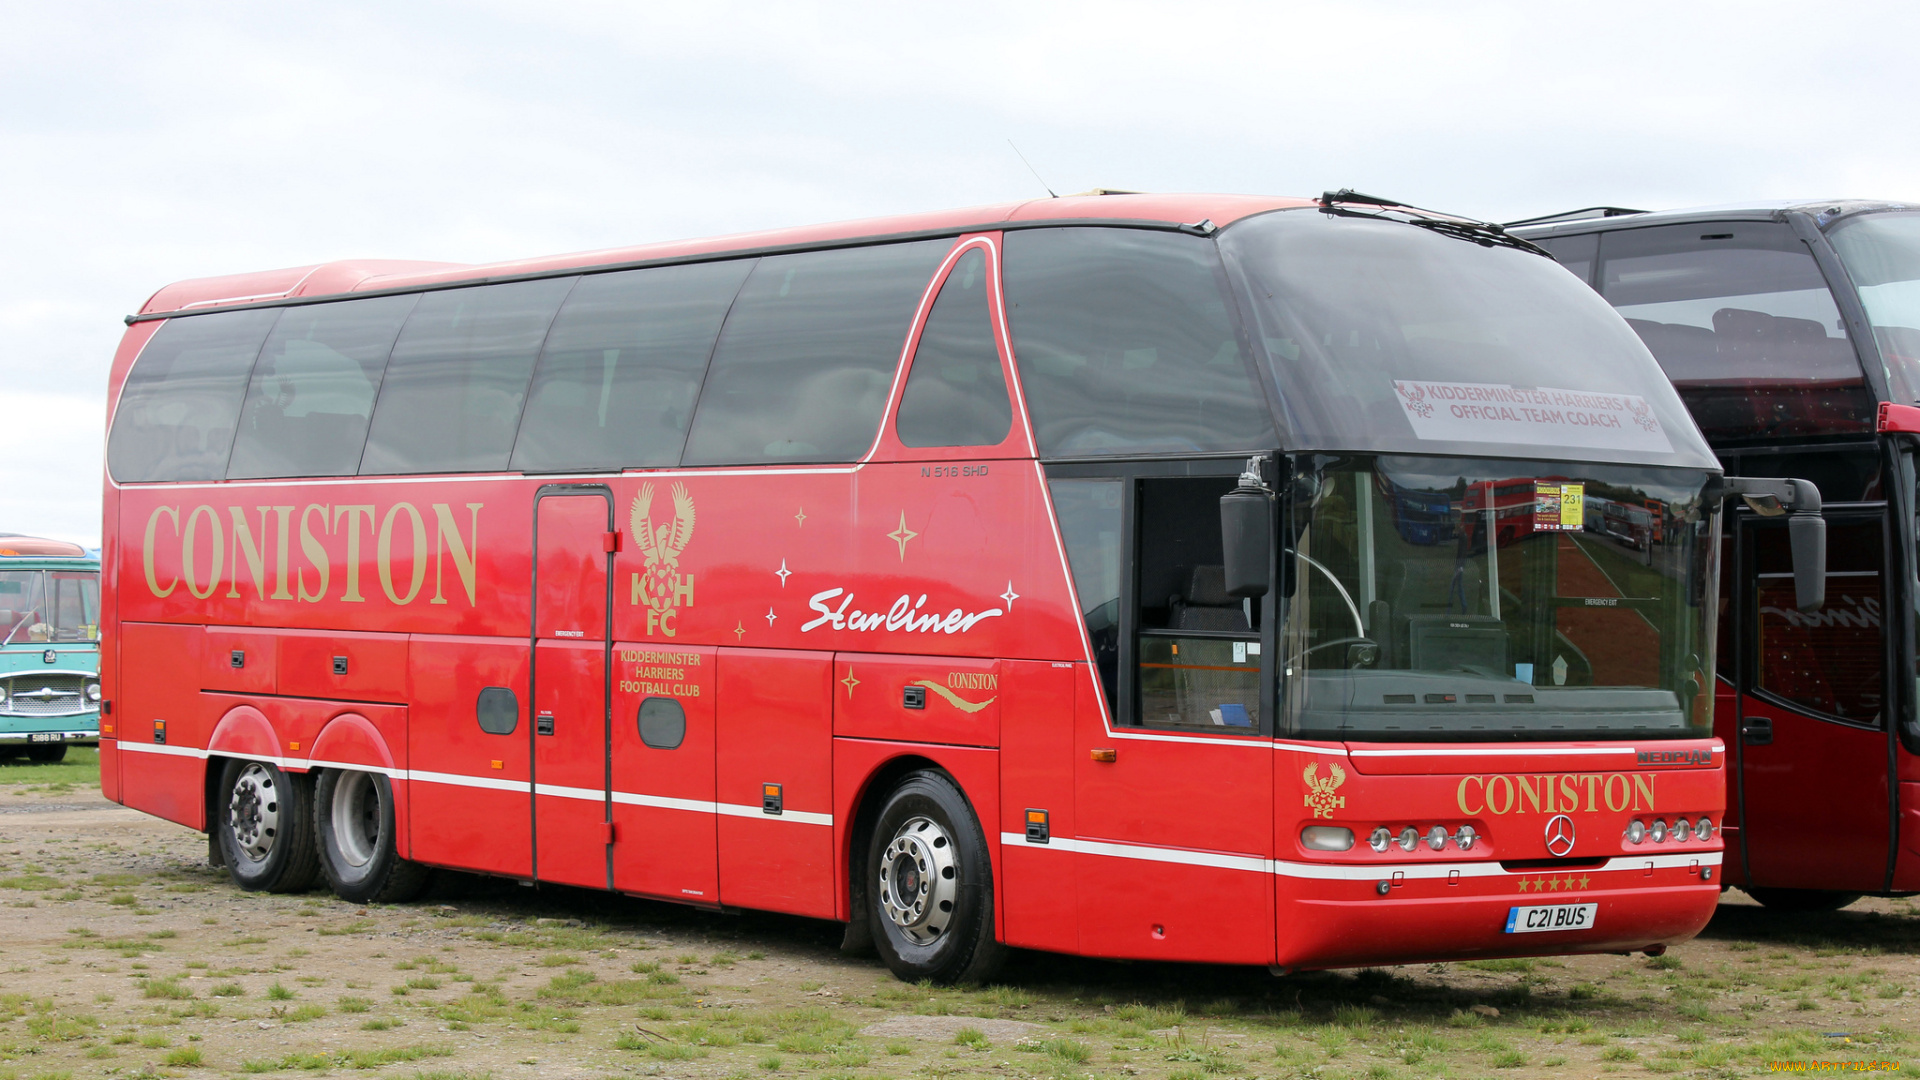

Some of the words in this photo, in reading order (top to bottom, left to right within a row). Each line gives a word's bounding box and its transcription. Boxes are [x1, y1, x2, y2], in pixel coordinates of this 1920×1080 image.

[1426, 385, 1549, 406] KIDDERMINSTER
[1551, 392, 1624, 411] HARRIERS
[1450, 404, 1521, 421] OFFICIAL
[1520, 408, 1566, 424] TEAM
[1566, 411, 1621, 428] COACH
[921, 466, 931, 477] N
[934, 466, 959, 477] 516
[962, 465, 989, 476] SHD
[1564, 494, 1581, 505] 231
[143, 501, 484, 608] CONISTON
[801, 587, 1003, 635] Starliner
[1585, 598, 1608, 606] EMERGENCY
[647, 608, 677, 637] FC
[621, 649, 701, 666] KIDDERMINSTER
[635, 665, 684, 680] HARRIERS
[948, 671, 998, 691] CONISTON
[620, 680, 671, 695] FOOTBALL
[673, 683, 700, 697] CLUB
[50, 733, 61, 742] RU
[1637, 748, 1712, 766] NEOPLAN
[1457, 774, 1656, 815] CONISTON
[1314, 808, 1334, 819] FC
[1554, 906, 1587, 926] BUS
